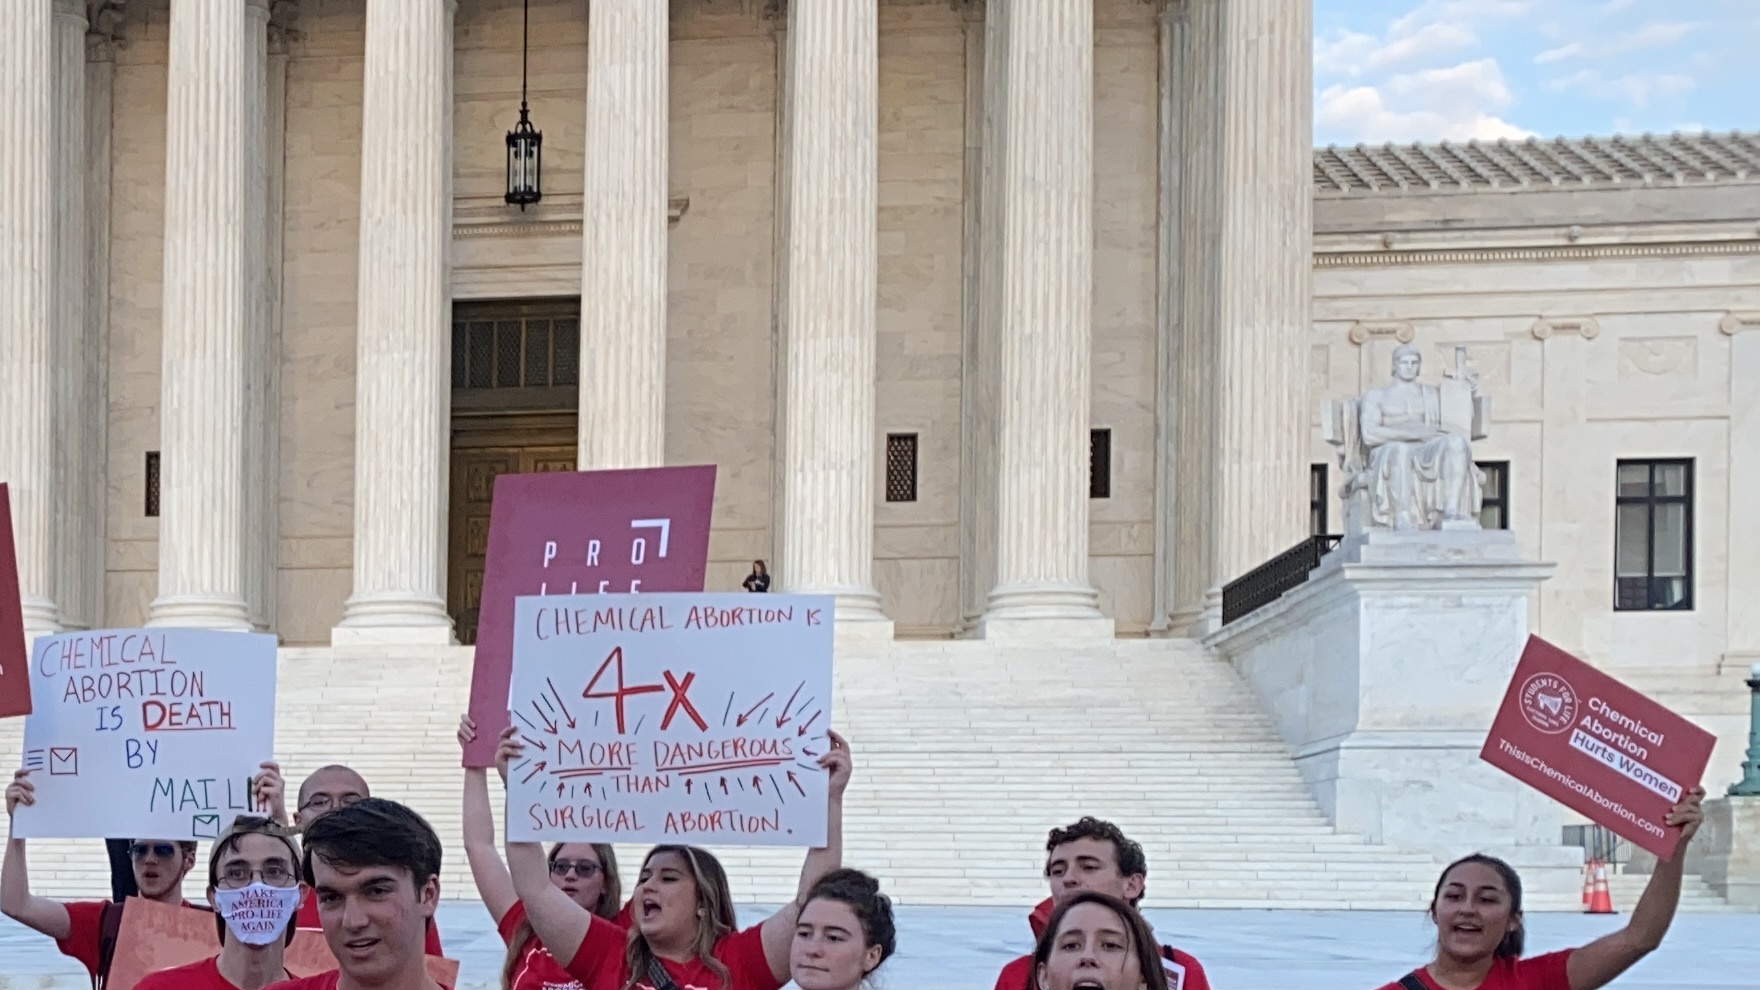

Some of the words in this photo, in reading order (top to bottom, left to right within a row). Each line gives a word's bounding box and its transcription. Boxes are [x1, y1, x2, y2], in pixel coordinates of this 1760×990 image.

[543, 537, 646, 568] PRO
[536, 604, 674, 641] CHEMICAL
[684, 603, 794, 630] ABORTION
[806, 609, 823, 626] IS
[40, 633, 177, 678] CHEMICAL
[63, 668, 204, 704] ABORTION
[1558, 685, 1573, 704] FOR
[95, 705, 123, 731] IS
[142, 700, 232, 731] DEATH
[1588, 697, 1665, 747] Chemical
[556, 738, 637, 767] MORE
[654, 737, 793, 768] DANGEROUS
[1580, 714, 1648, 760] Abortion
[126, 738, 158, 769] BY
[1573, 730, 1615, 763] Hurts
[1619, 757, 1679, 799] Women
[611, 775, 670, 793] THAN
[1499, 738, 1665, 839] ThisIsChemicalAbortion.com
[529, 803, 646, 832] SURGICAL
[231, 899, 284, 911] AMERICA
[240, 888, 277, 899] MAKE
[231, 909, 283, 921] PRO-LIFE
[241, 920, 276, 931] AGAIN
